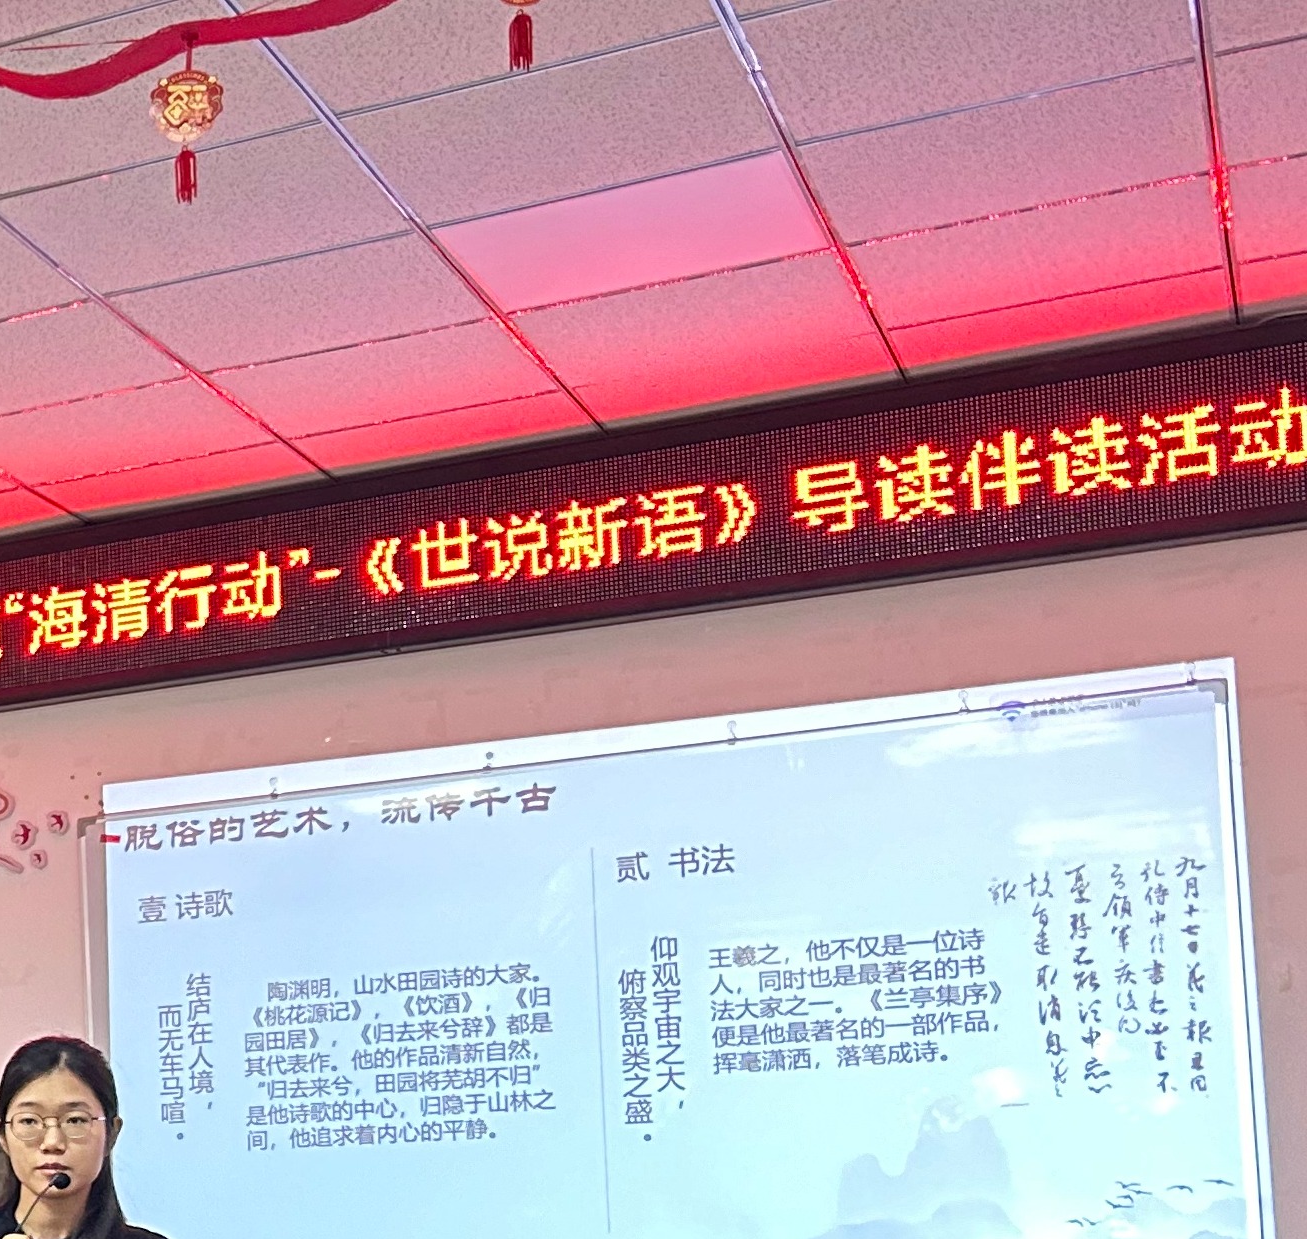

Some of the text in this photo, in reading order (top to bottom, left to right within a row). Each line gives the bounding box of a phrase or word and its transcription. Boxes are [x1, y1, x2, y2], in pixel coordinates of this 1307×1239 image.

[615, 844, 736, 883] 贰 书法
[137, 889, 234, 924] 壹 诗歌
[708, 928, 985, 971] 王羲之，他不仅是一位诗
[267, 962, 541, 1002] 陶渊明，山水田园诗的大家。
[709, 956, 987, 997] 人，同时也是最著名的书
[711, 1008, 1000, 1049] 便是他最著名的一部作品，
[244, 1039, 540, 1077] 其代表作。他的作品清新自然，
[712, 1042, 951, 1076] 挥毫潇洒，落笔成诗。
[245, 1091, 557, 1127] 是他诗歌的中心，归隐于山林之
[246, 1118, 498, 1152] 间，他追求着内心的平静。
